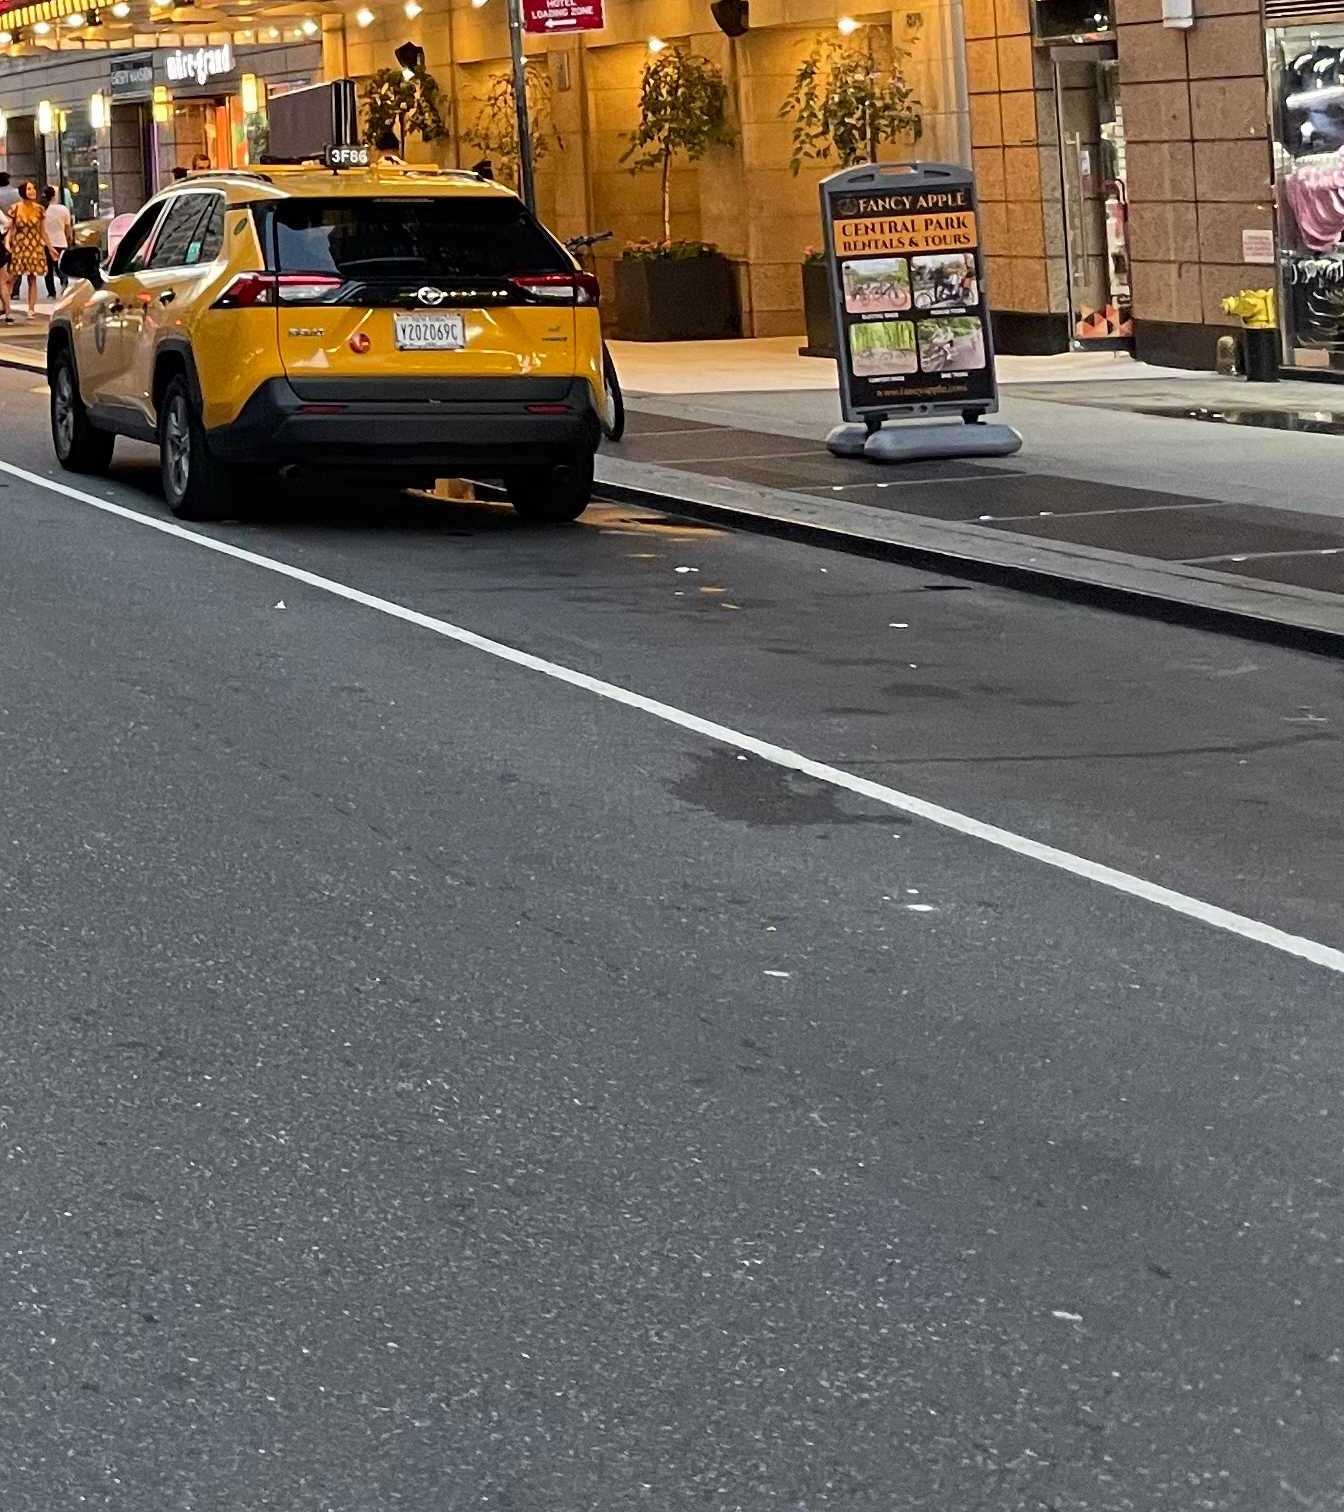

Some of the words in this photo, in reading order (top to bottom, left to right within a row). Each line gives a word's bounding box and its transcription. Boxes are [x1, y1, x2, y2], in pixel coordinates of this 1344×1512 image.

[531, 8, 569, 20] LOADING
[570, 5, 594, 16] ZONE
[331, 148, 369, 164] 3F86
[859, 195, 913, 214] FANCY
[916, 192, 967, 210] APPLE
[842, 219, 917, 237] CENTRAL
[924, 216, 969, 232] PARK
[843, 237, 906, 252] RENTALS
[908, 237, 920, 247] &
[924, 233, 971, 247] TOURS
